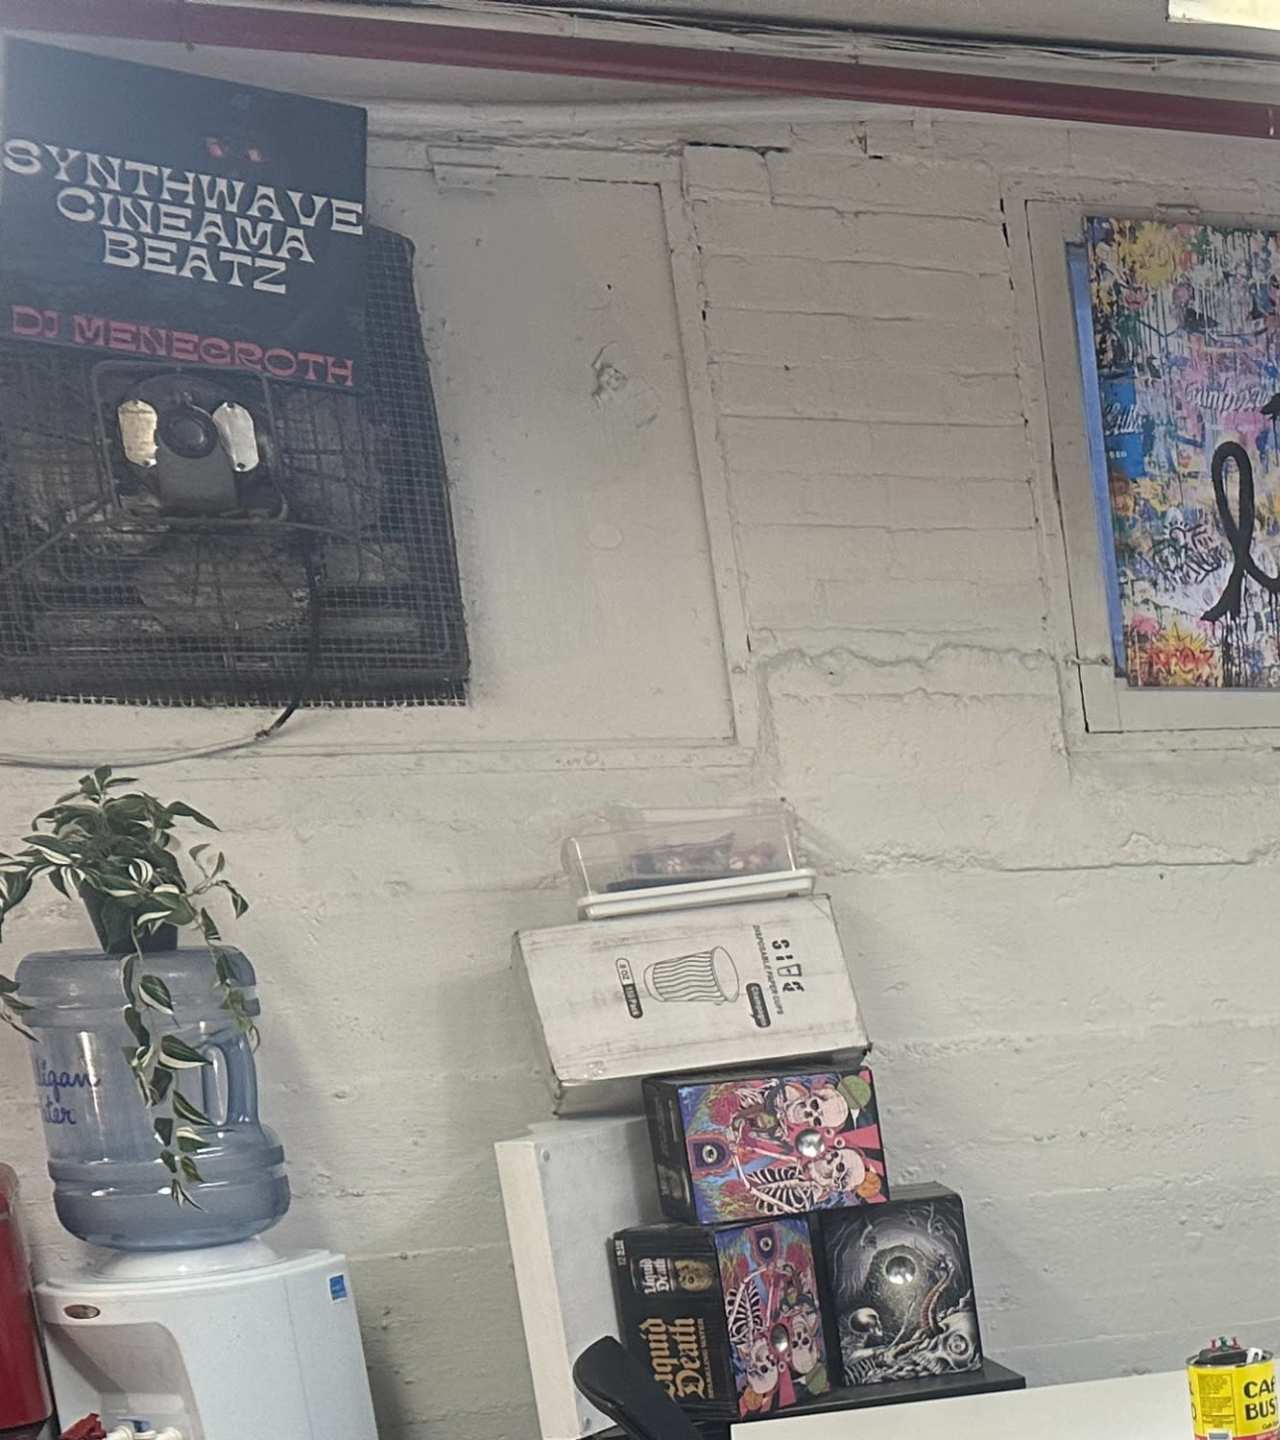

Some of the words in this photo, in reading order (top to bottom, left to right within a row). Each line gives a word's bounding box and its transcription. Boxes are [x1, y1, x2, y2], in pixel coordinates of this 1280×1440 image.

[3, 139, 364, 236] SYNTHWAVE
[57, 186, 315, 263] CINEAMA
[103, 229, 287, 294] BEATZ
[12, 304, 60, 338] DJ
[73, 315, 354, 387] MENEGROTH
[667, 1318, 707, 1399] Death
[1244, 1396, 1279, 1421] BUS
